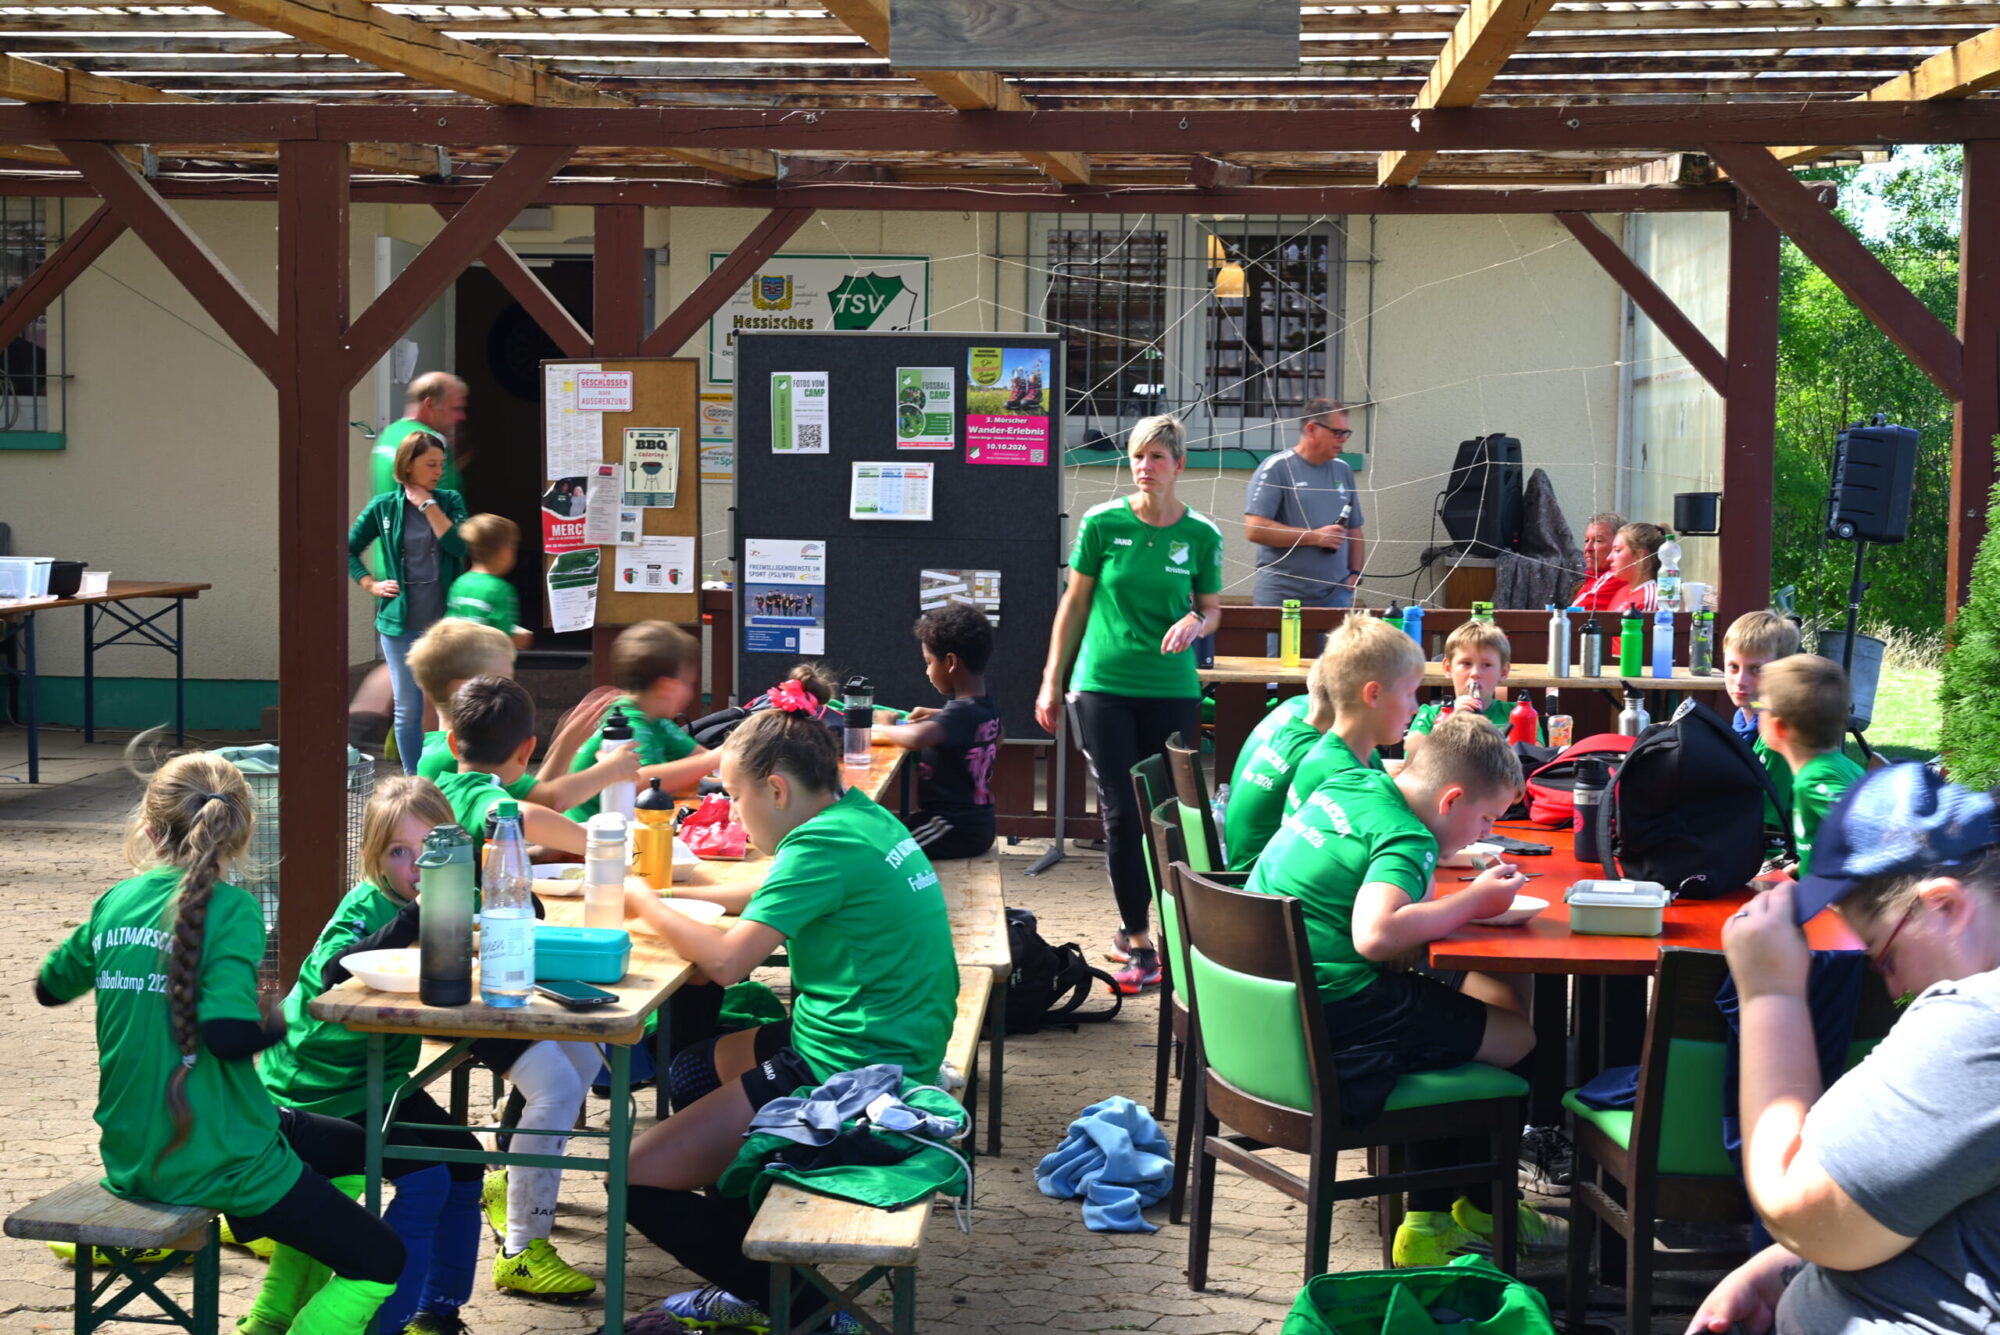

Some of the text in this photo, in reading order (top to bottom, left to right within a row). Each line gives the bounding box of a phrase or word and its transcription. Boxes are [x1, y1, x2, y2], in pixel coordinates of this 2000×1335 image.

[836, 293, 886, 316] TSV
[733, 314, 814, 329] Hessisches
[581, 378, 628, 387] GESCHLOSSEN
[793, 379, 825, 388] FOTOS VOM
[922, 381, 951, 390] FUSSBALL
[804, 389, 825, 397] CAMP
[929, 391, 950, 400] CAMP
[581, 397, 628, 405] AUSGRENZUNG
[968, 426, 1045, 436] Wander-Erlebnis
[635, 439, 668, 451] BBQ
[986, 443, 1027, 451] 10.10.2026
[1165, 565, 1191, 575] Kristina
[885, 848, 904, 870] TSV
